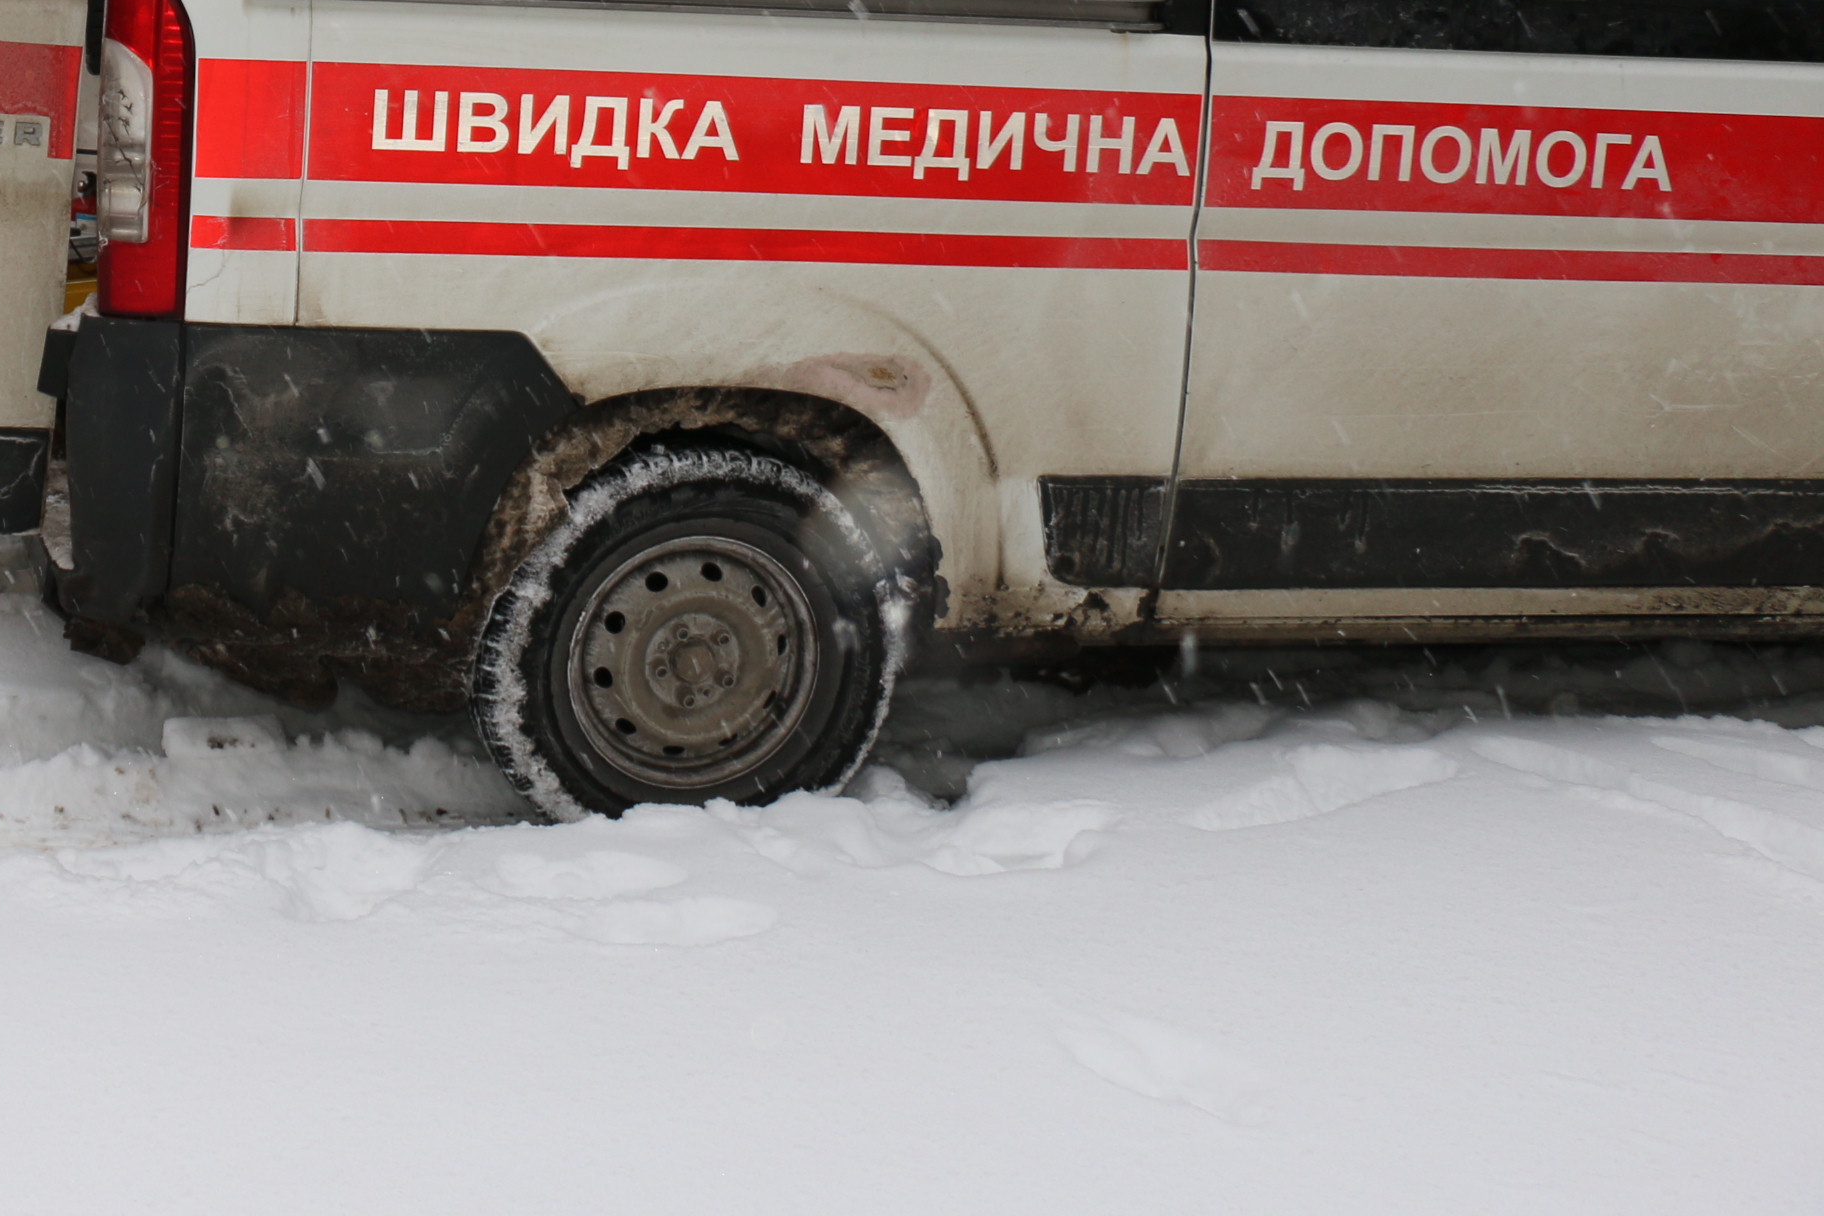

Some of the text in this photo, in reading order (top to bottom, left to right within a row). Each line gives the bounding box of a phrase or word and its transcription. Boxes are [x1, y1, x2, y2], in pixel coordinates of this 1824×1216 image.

[371, 88, 1673, 192] ШВИДКА МЕДИЧНА ДОПОМОГА
